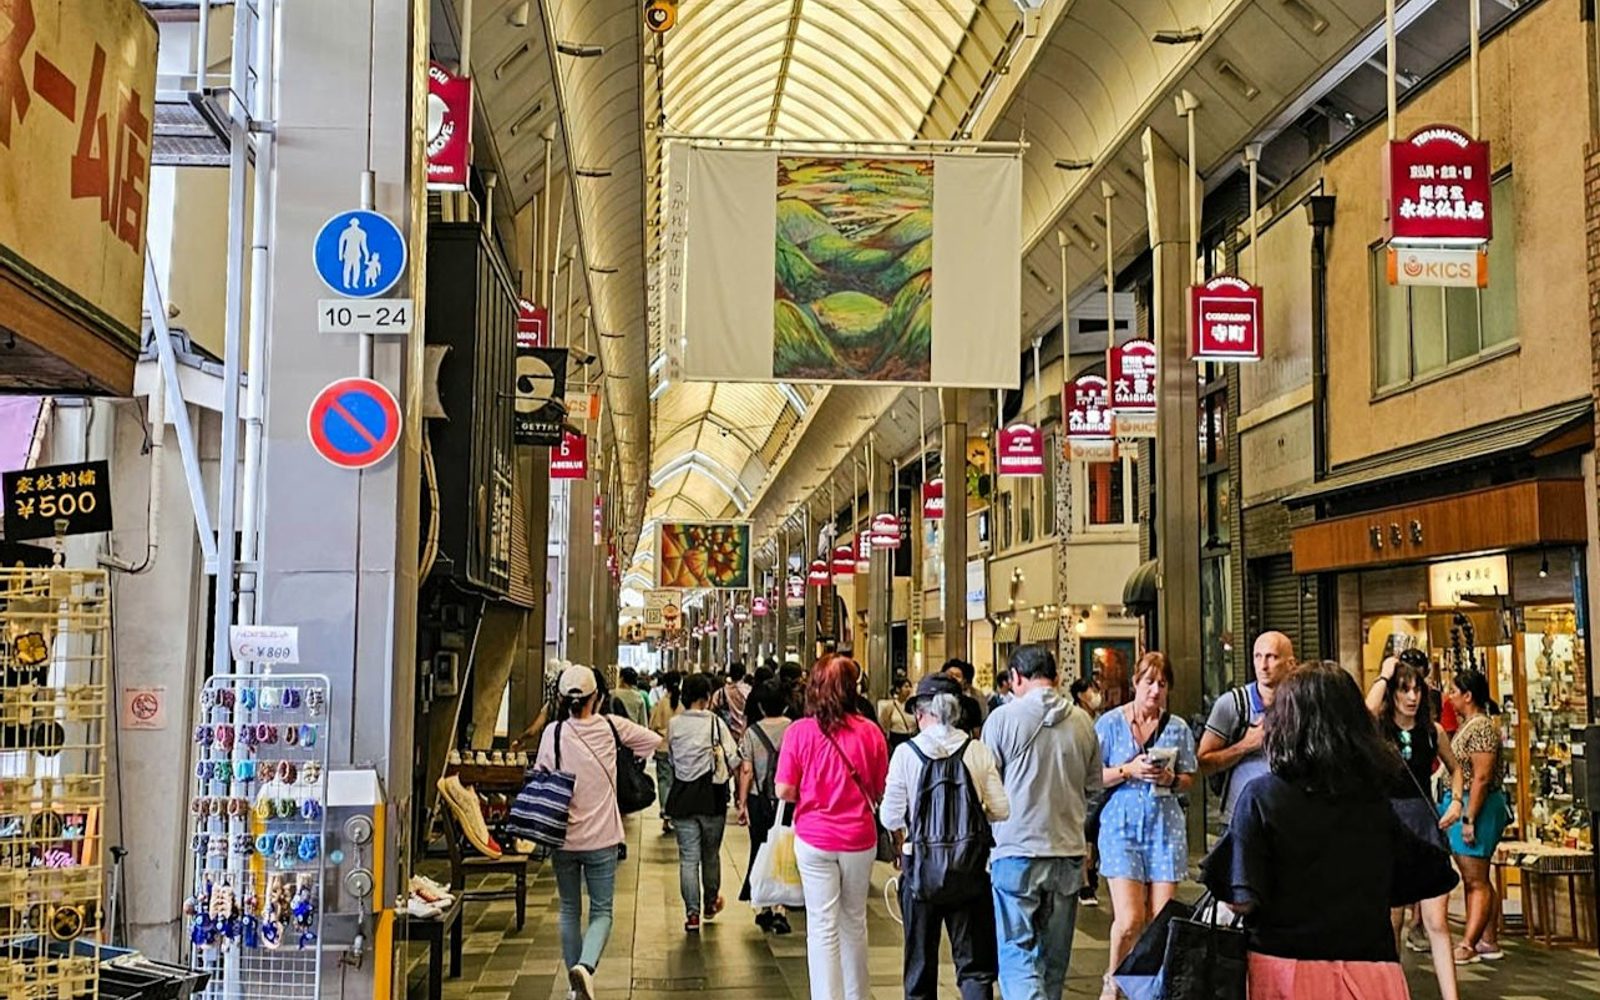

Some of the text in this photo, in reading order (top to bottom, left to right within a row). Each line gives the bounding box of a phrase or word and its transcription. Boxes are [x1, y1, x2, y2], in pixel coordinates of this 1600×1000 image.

[1411, 129, 1469, 148] TERAMACHI
[1426, 263, 1471, 278] KICS
[326, 307, 406, 327] 10-24
[1211, 324, 1246, 343] 寺町
[15, 491, 97, 520] ¥500
